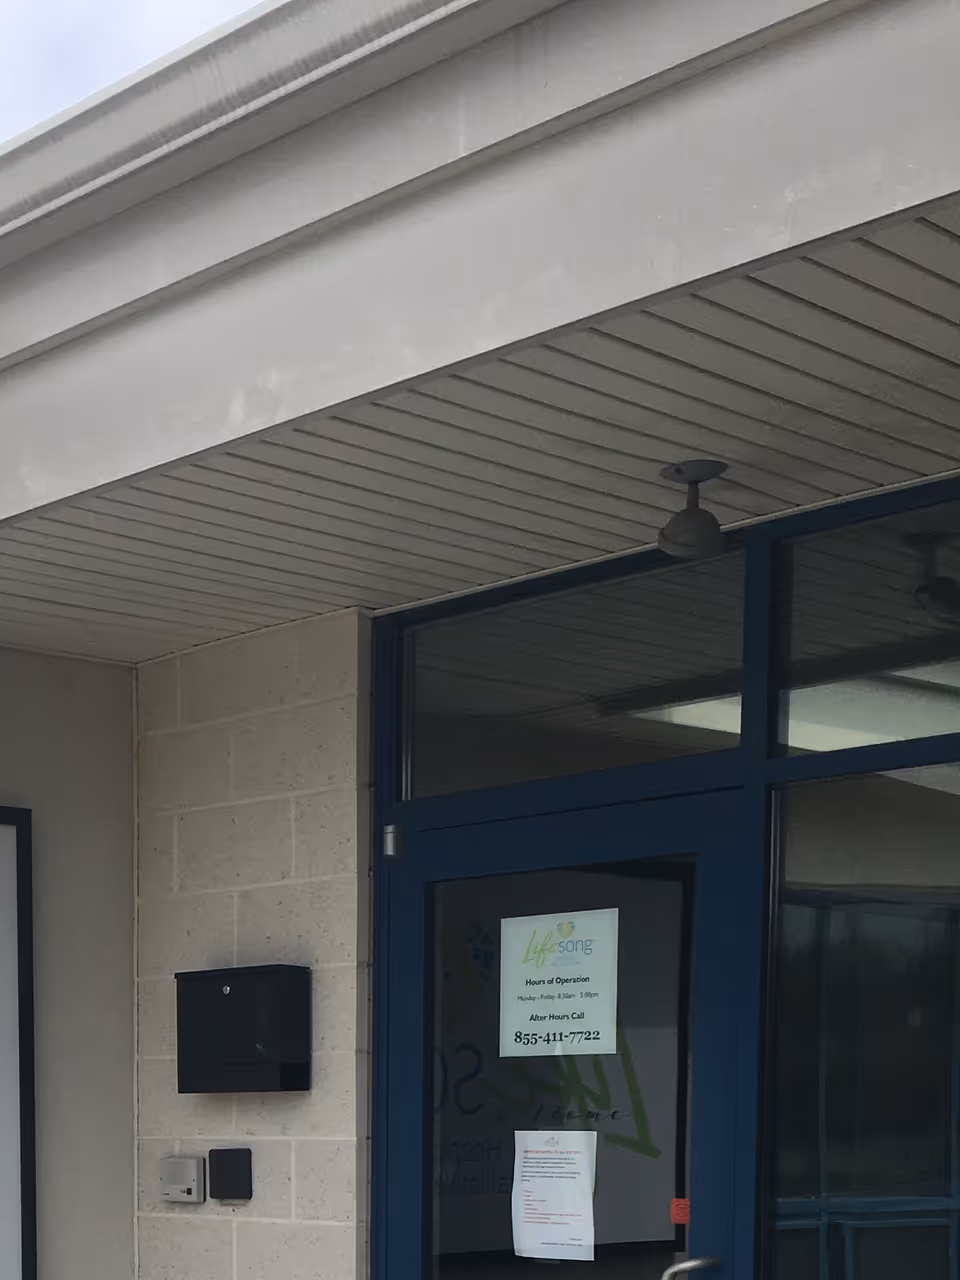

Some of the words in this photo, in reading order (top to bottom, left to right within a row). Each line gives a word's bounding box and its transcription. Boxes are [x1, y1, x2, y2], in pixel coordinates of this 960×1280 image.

[525, 978, 546, 986] Hours
[547, 977, 554, 985] of
[555, 975, 590, 985] Operation
[580, 991, 599, 999] 500pm
[529, 1013, 547, 1022] After
[548, 1013, 569, 1021] Hours
[571, 1011, 585, 1020] Call
[514, 1030, 600, 1046] 855-411-7722
